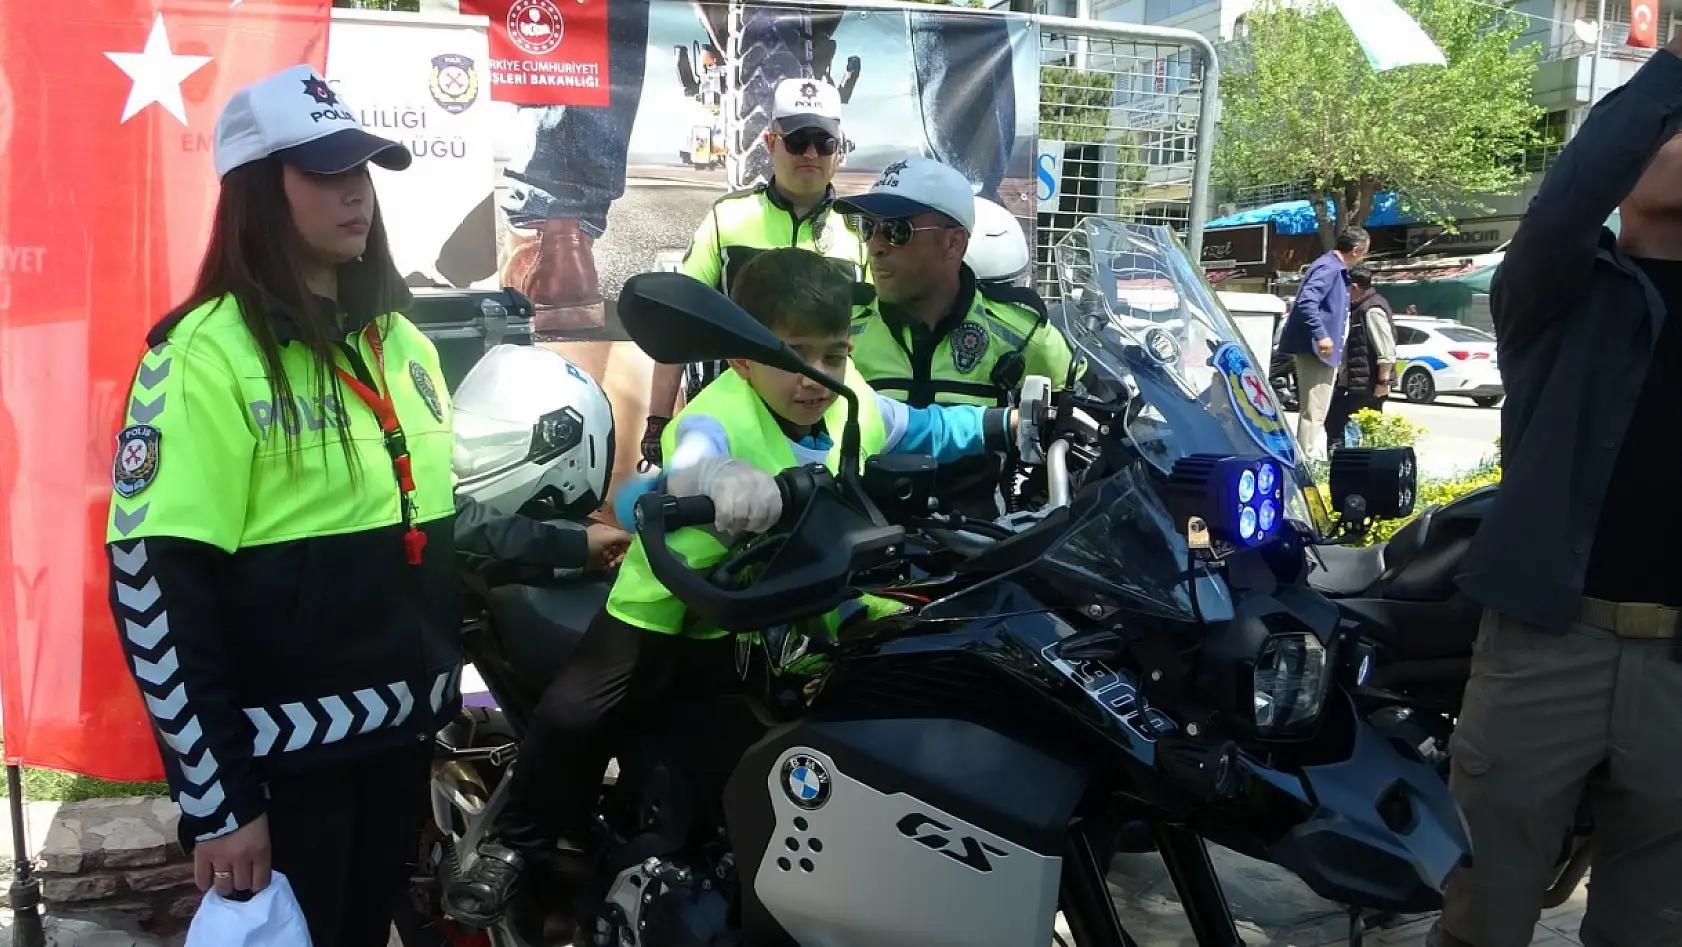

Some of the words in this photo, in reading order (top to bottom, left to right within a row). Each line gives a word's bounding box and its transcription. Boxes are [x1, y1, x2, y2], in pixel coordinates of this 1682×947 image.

[489, 58, 520, 71] RKİYE
[522, 60, 599, 75] CUMHURİYETİ
[491, 72, 528, 85] ŞLERİ
[530, 73, 600, 88] BAKANLIĞI
[360, 104, 427, 129] LİLİĞİ
[784, 757, 829, 784] BMW
[895, 811, 1010, 873] GS
